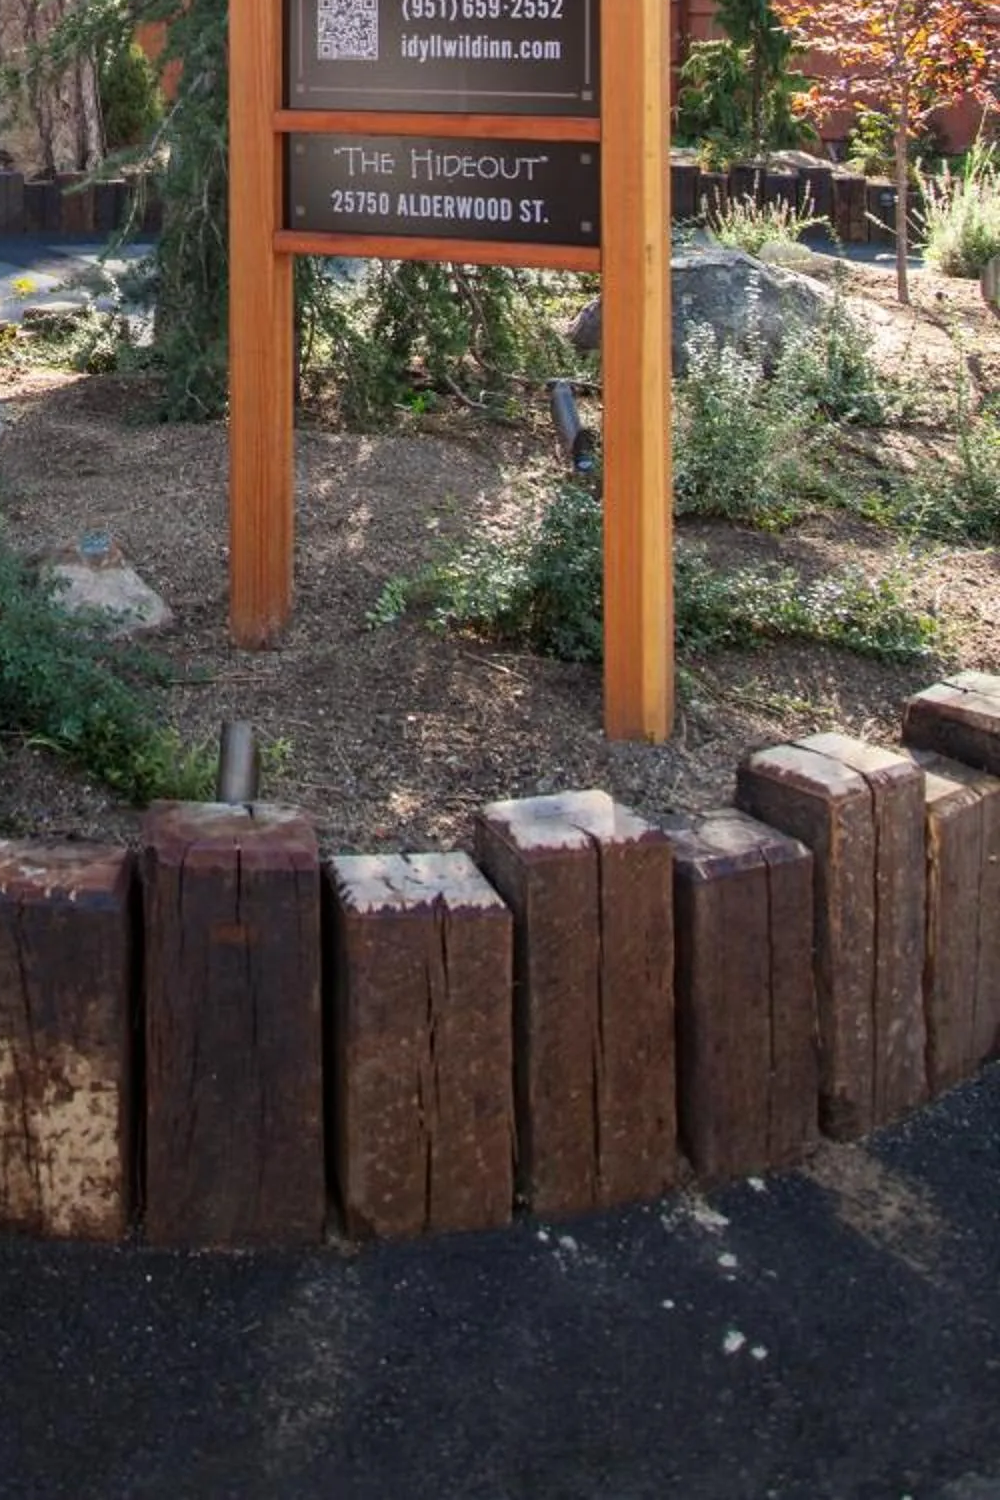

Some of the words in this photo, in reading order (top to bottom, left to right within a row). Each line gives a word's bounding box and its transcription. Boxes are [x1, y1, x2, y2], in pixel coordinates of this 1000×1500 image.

[401, 35, 561, 63] idyllwildinn.com
[331, 189, 389, 214] 25750
[397, 193, 512, 222] ALDERWOOD
[518, 199, 549, 224] ST.
